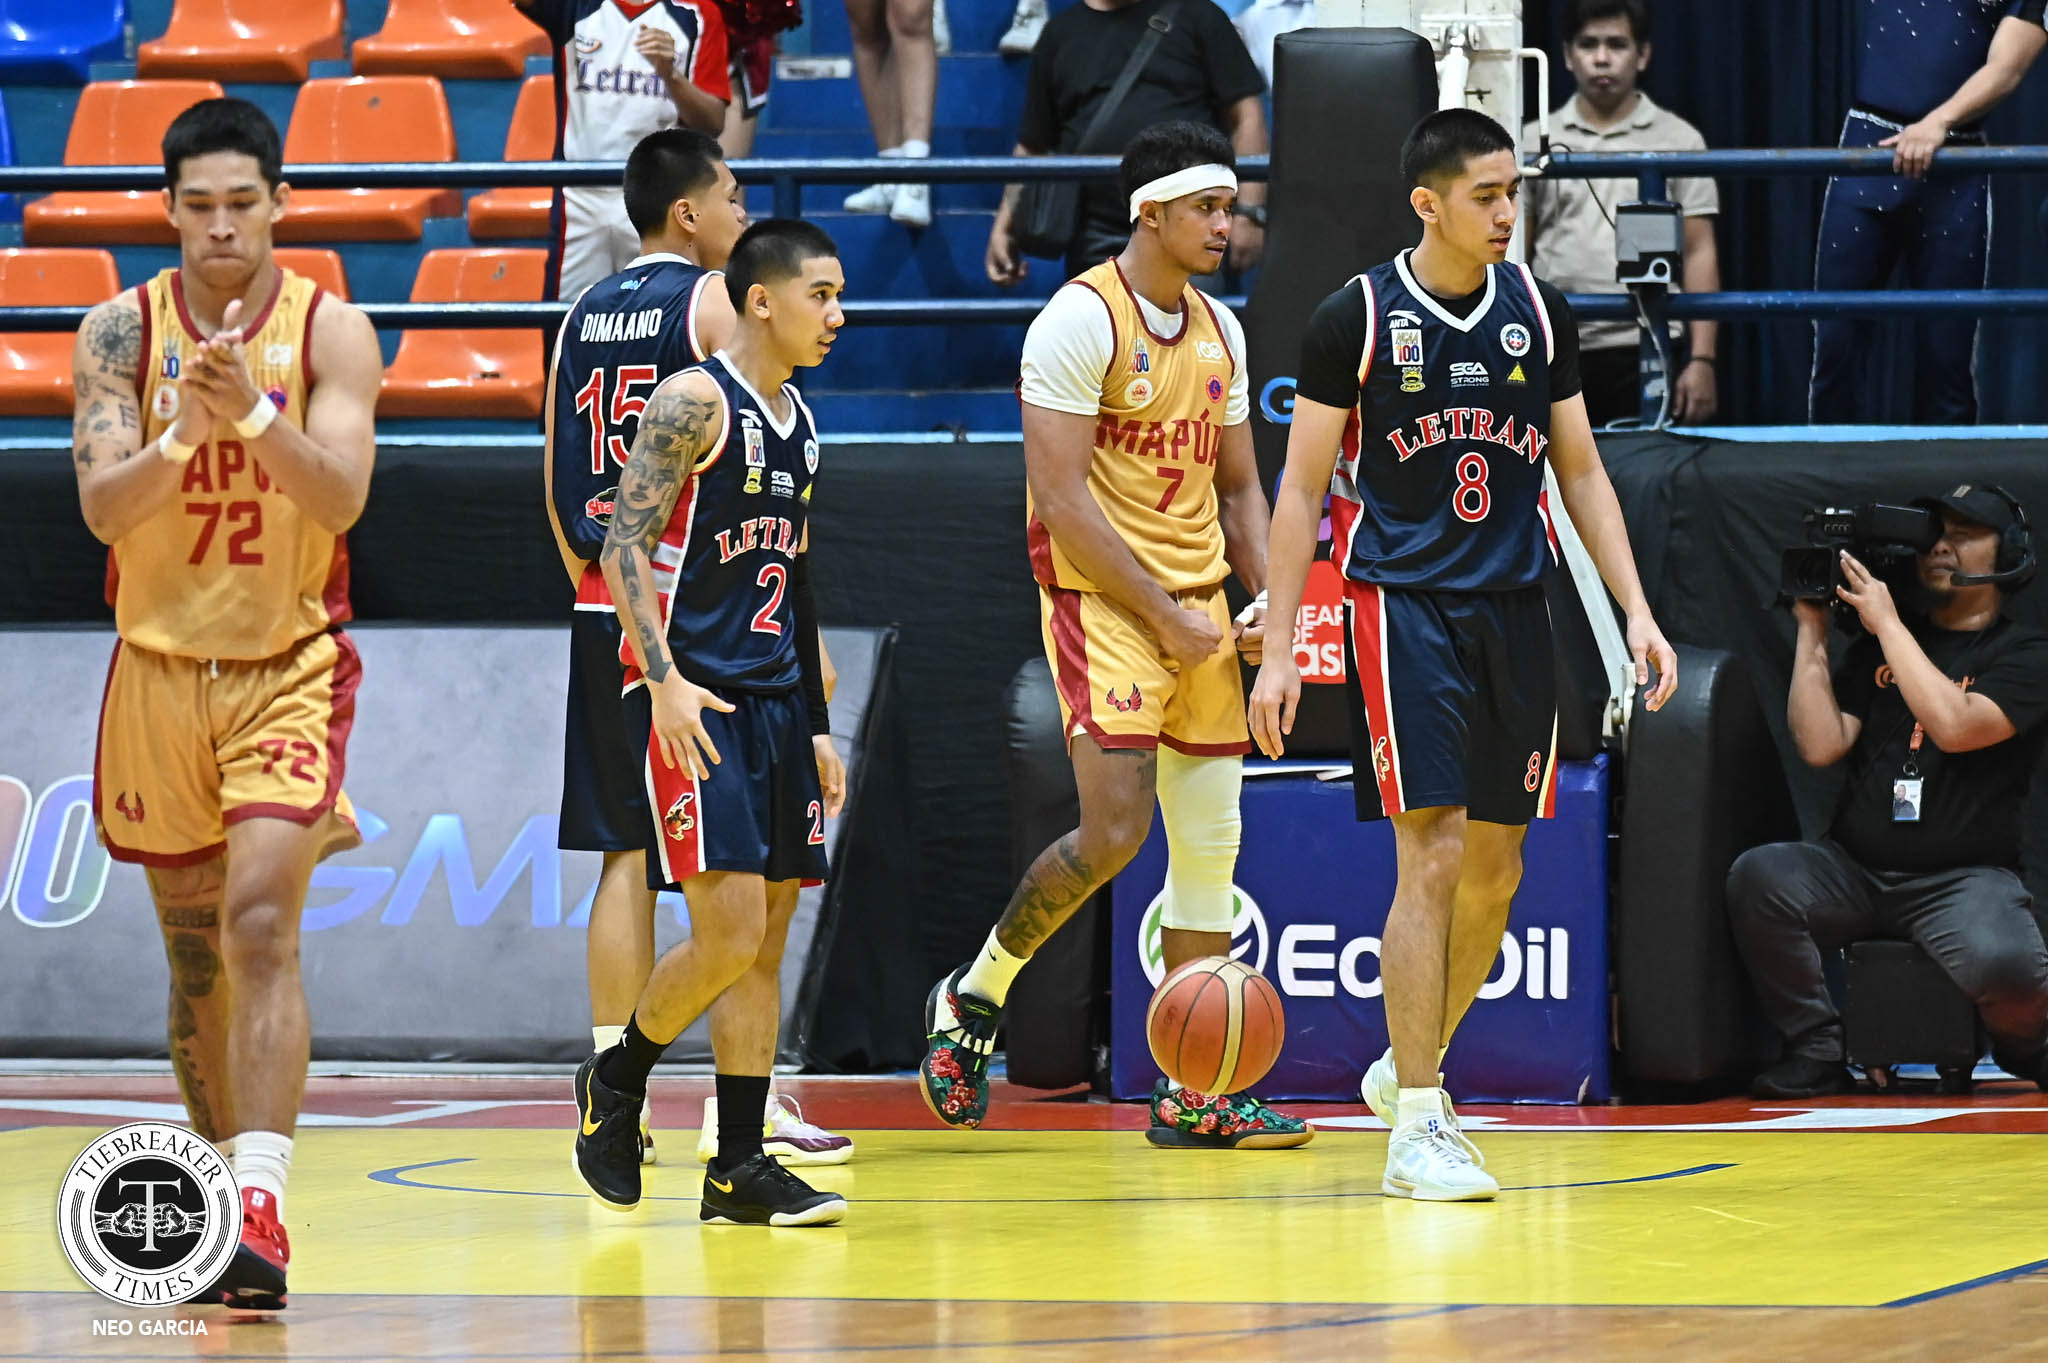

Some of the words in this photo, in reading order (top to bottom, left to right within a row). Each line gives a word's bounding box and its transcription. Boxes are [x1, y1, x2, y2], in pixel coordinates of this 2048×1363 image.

[575, 59, 669, 100] Letra
[580, 308, 663, 342] DIMAANO
[1389, 318, 1409, 329] ANTA
[1396, 345, 1420, 362] 100
[1449, 361, 1489, 377] SGA
[1450, 376, 1490, 385] STRONG
[575, 365, 658, 474] 15
[1386, 407, 1548, 464] LETRAN
[1156, 466, 1185, 514] 7
[1453, 452, 1491, 523] 8
[185, 500, 263, 566] 72
[714, 516, 798, 564] LETRA
[750, 562, 787, 637] 2
[257, 739, 320, 784] 72
[1524, 751, 1541, 792] 8
[807, 800, 824, 845] 2
